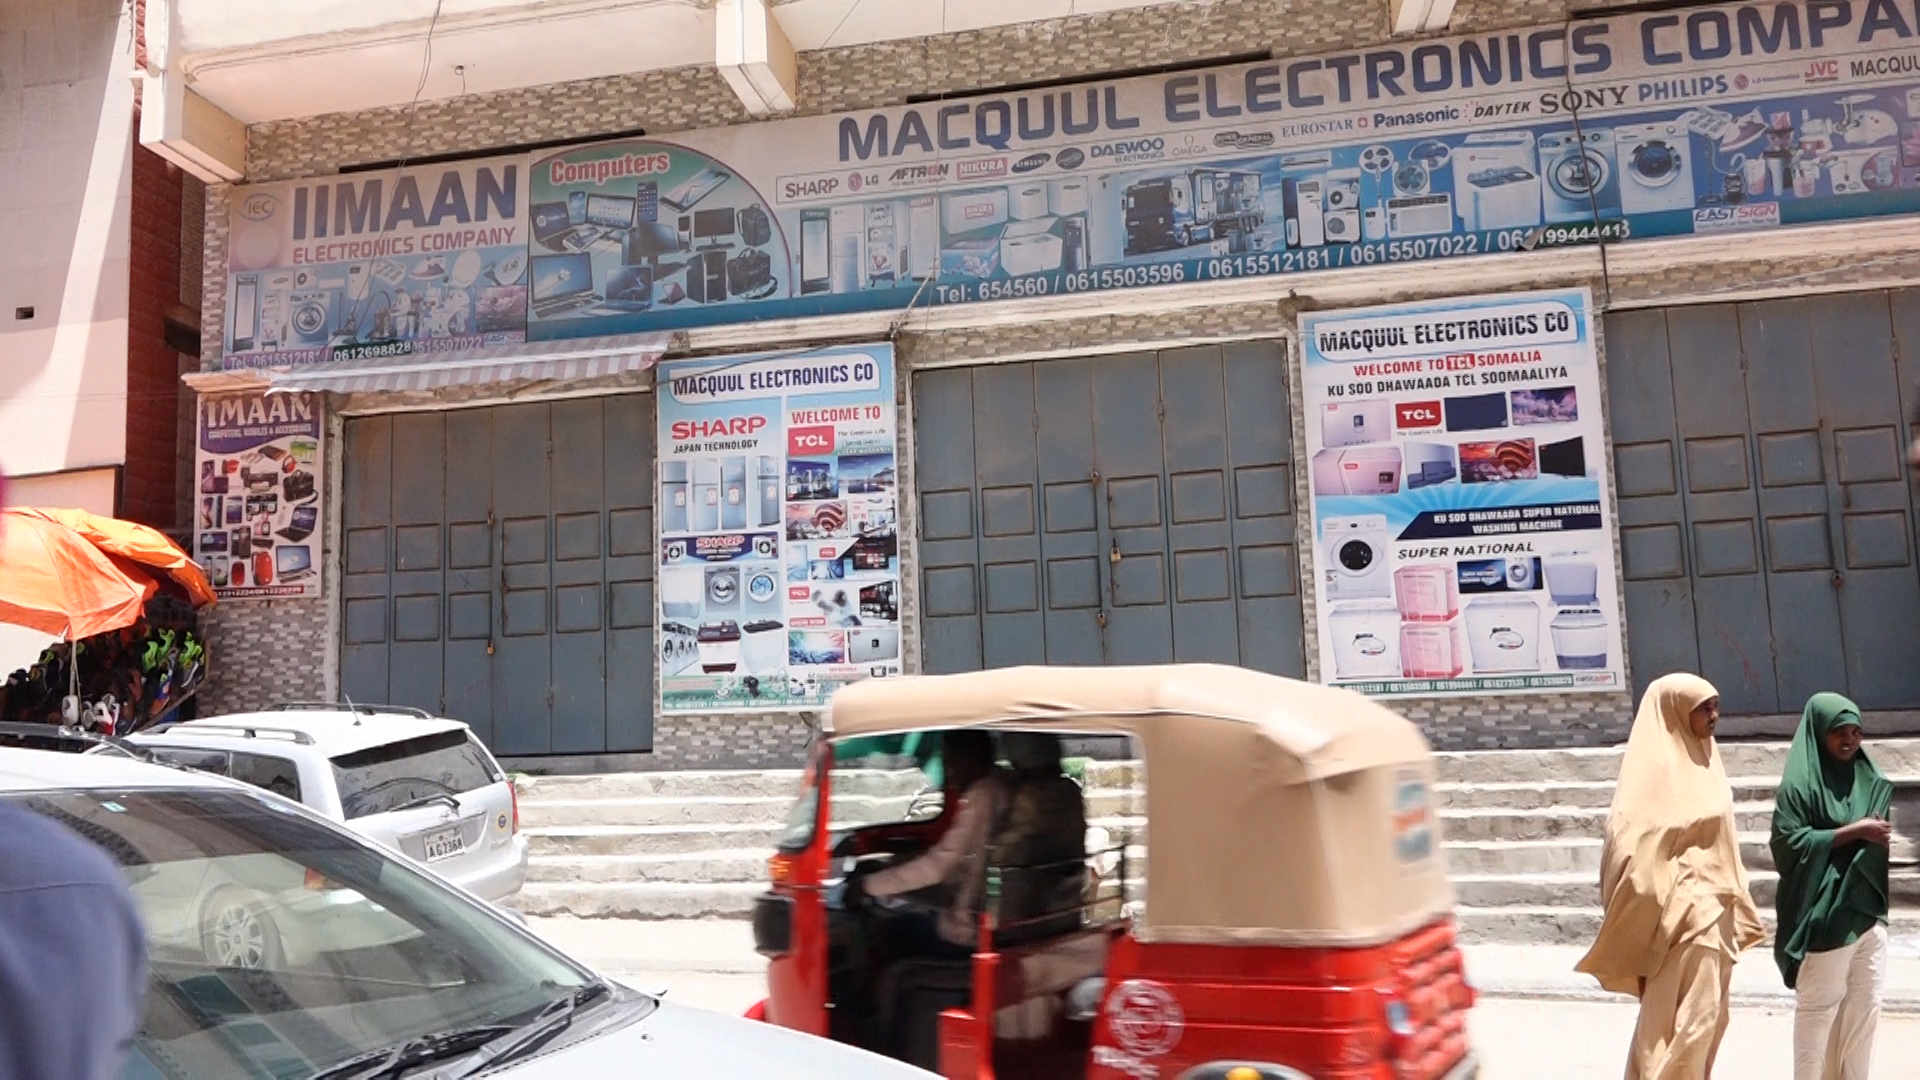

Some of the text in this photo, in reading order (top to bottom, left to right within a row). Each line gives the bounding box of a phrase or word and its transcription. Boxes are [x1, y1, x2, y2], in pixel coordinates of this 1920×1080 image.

[1804, 60, 1839, 78] JVC
[839, 86, 1140, 162] MACQUUL
[1164, 23, 1611, 122] ELECTRONICS
[1638, 74, 1729, 101] PHILIPS
[1474, 101, 1531, 118] DAYTEK
[1540, 85, 1630, 115] SONY
[1282, 119, 1353, 137] EUROSTAR
[1374, 106, 1460, 129] Panasonic
[1091, 138, 1165, 157] DAEWOO
[551, 153, 669, 183] Computers
[888, 163, 949, 181] AFTRON
[959, 157, 1005, 174] NIKURA
[785, 177, 840, 198] SHARP
[865, 174, 879, 186] LG
[293, 165, 517, 240] IIMAAN
[293, 226, 516, 264] ELECTRONICS COMPANY
[979, 277, 1048, 300] 654560
[1065, 263, 1185, 291] 0615503596
[1208, 246, 1330, 278] 0615512181
[1351, 234, 1478, 265] 0615507022
[1320, 311, 1569, 352] MACQUUL ELECTRONICS CO
[1354, 350, 1542, 376] WELCOME TO TCL SOMALIA
[673, 363, 874, 397] MACQUUL ELECTRONICS CO
[1328, 367, 1568, 396] KU SOO DHAWAADA TCL SOOMAALIYA
[206, 393, 312, 428] IMAAN
[792, 405, 881, 424] WELCOME TO
[1401, 409, 1436, 420] TCL
[671, 416, 767, 440] SHARP
[673, 439, 758, 454] JAPAN TECHNOLOGY
[794, 435, 829, 447] TCL
[1434, 514, 1446, 524] KU
[1522, 507, 1552, 518] SUPER
[1553, 504, 1600, 515] NATIONAL
[1472, 519, 1563, 534] WASHING MACHINE
[1398, 541, 1535, 560] SUPER NATIONAL
